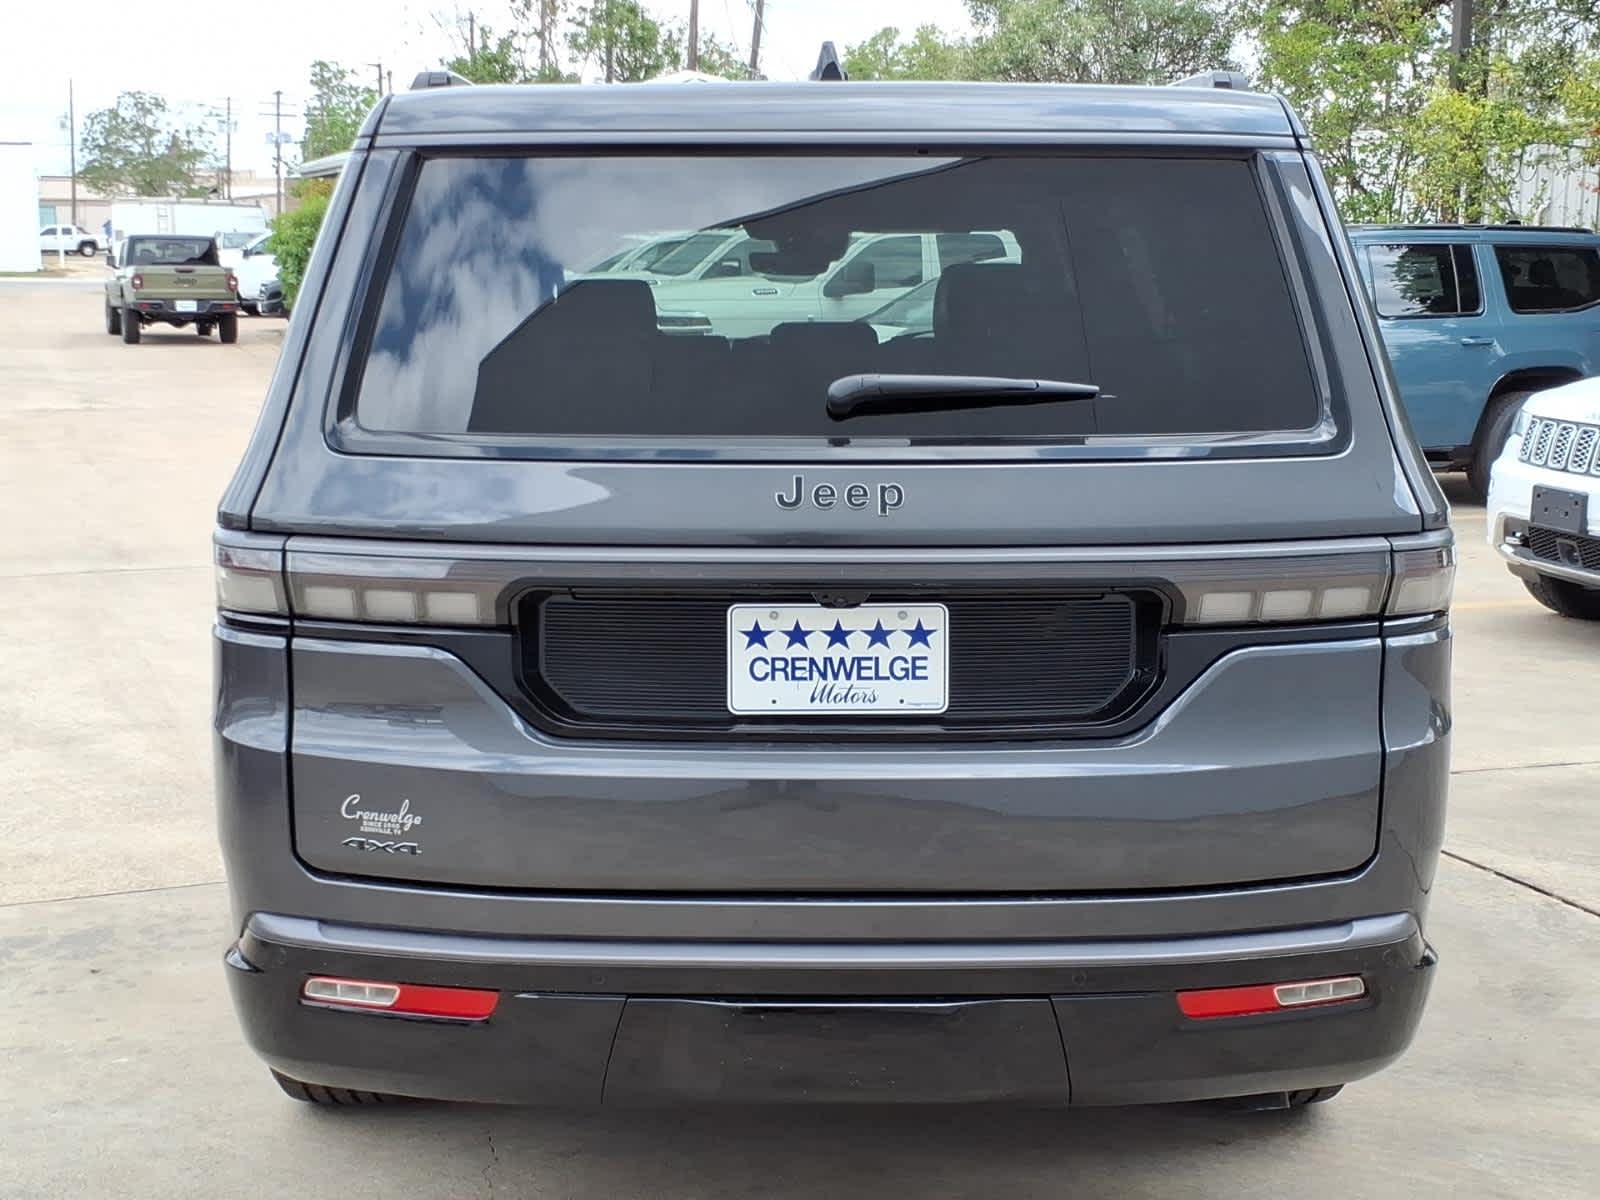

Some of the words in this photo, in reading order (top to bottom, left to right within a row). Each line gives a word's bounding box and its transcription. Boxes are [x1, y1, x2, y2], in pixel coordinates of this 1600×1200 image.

[775, 474, 905, 516] Jeep
[749, 656, 929, 681] CRENWELGE
[810, 683, 879, 704] Motors
[341, 793, 423, 831] Crenwelge
